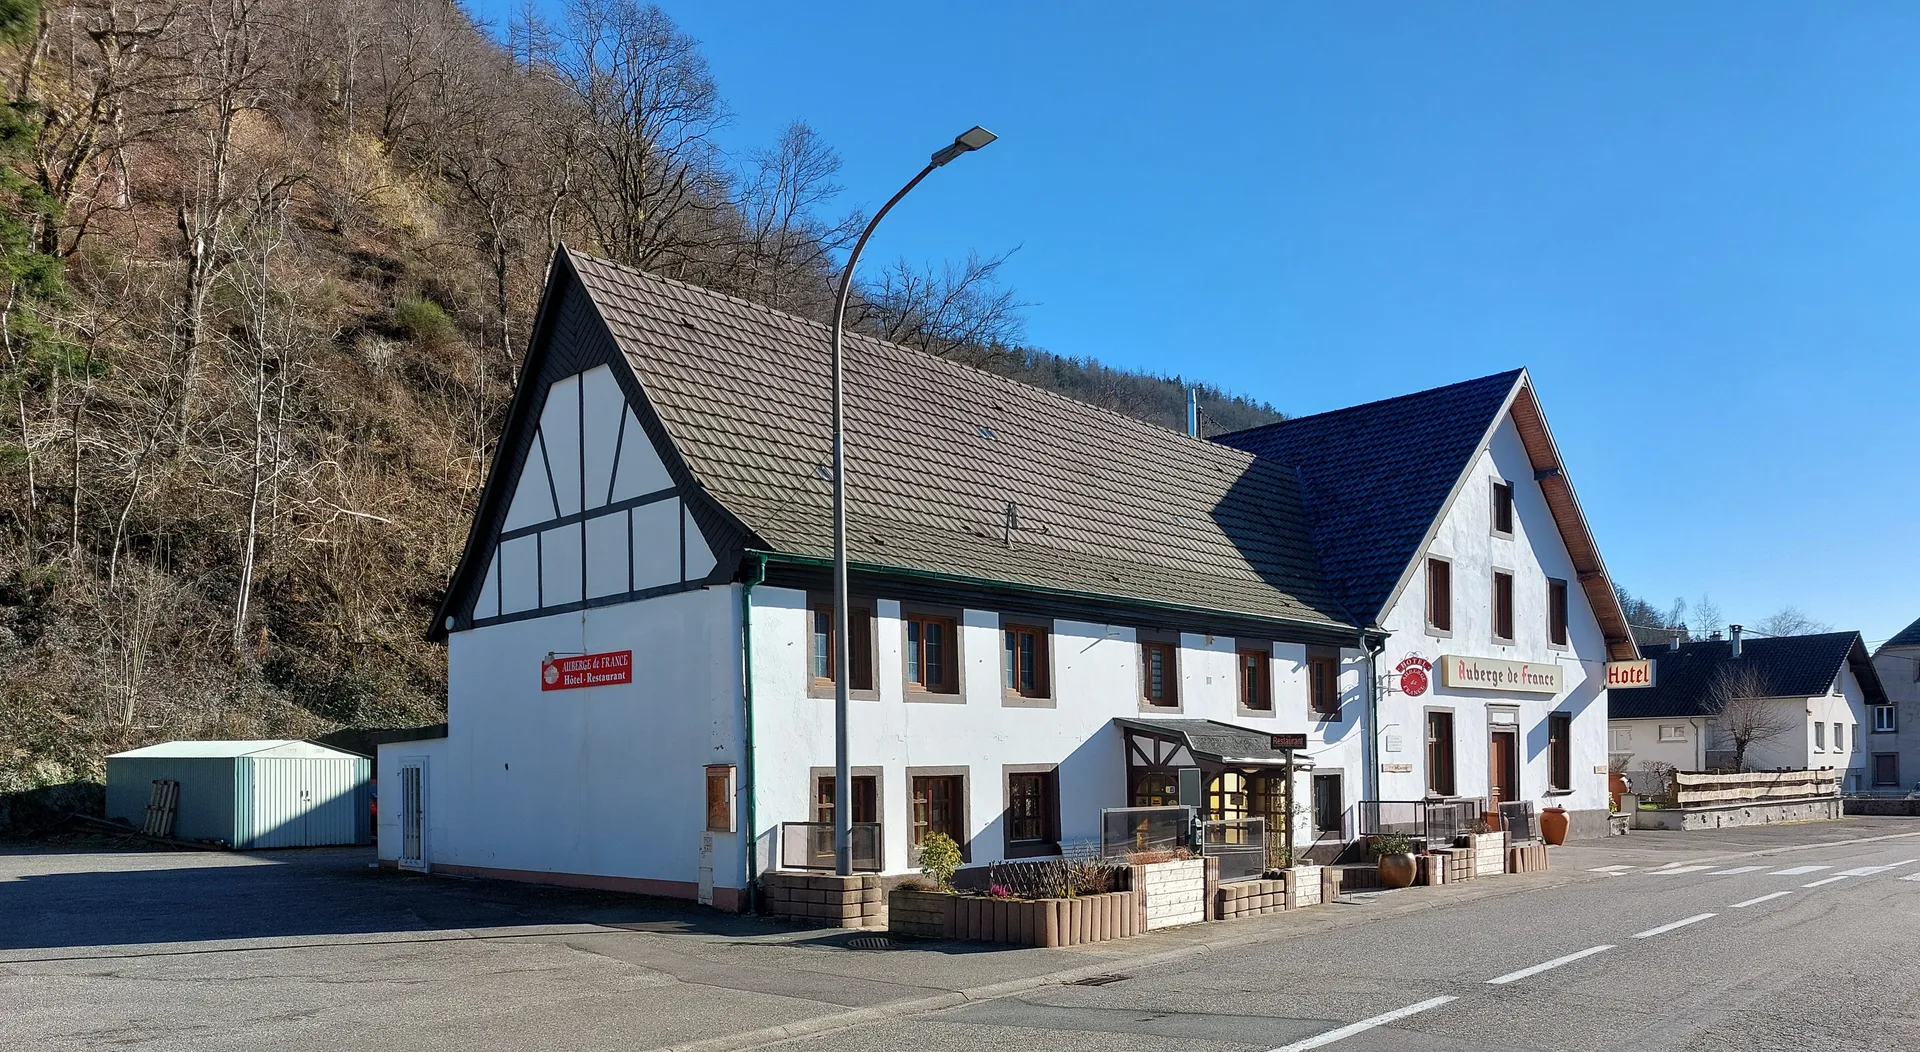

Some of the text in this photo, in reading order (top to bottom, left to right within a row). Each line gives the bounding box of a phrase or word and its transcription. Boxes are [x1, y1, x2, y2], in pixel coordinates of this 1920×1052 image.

[562, 654, 628, 672] AUBERGE de FRANCE
[1400, 658, 1426, 668] HOTEL
[1402, 669, 1426, 682] AUBERGE
[1459, 659, 1554, 687] Auberge de France
[1608, 664, 1649, 684] Hotel
[1403, 685, 1425, 695] FRANCE
[1272, 736, 1304, 745] Restaurant
